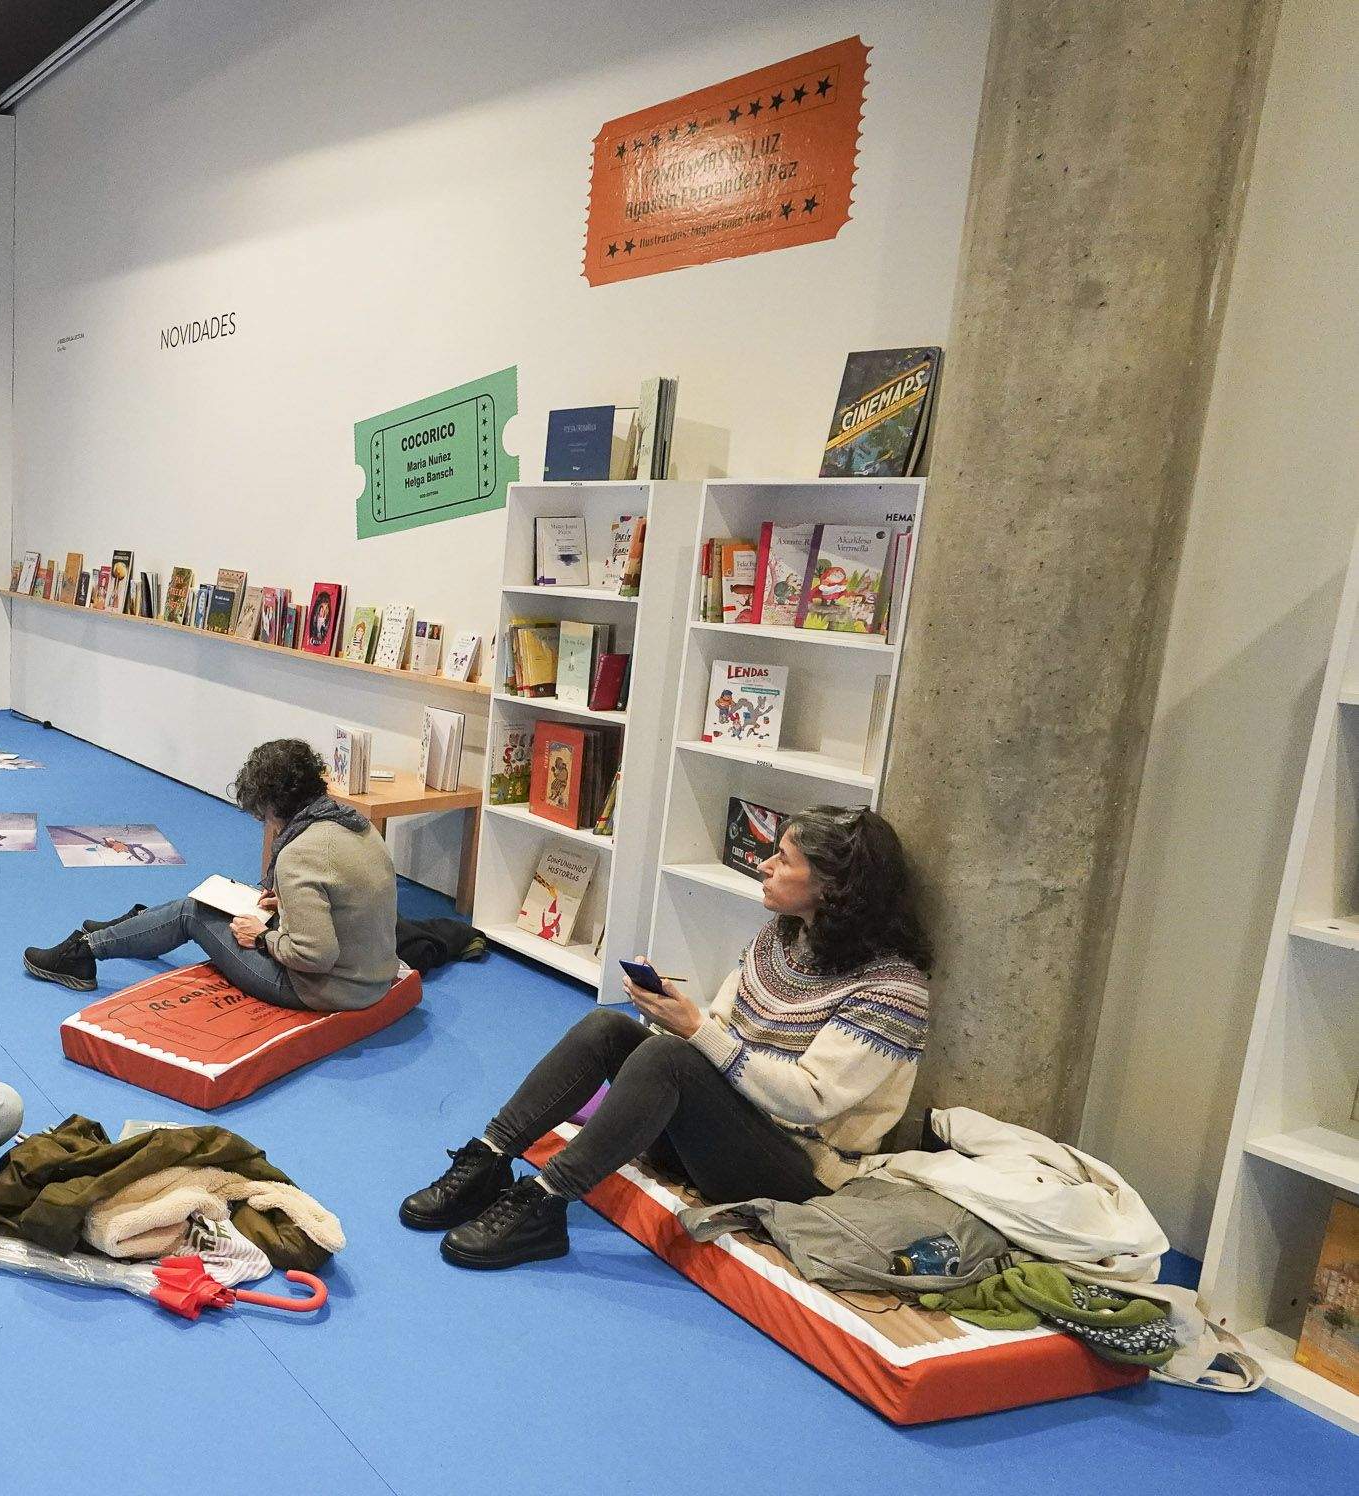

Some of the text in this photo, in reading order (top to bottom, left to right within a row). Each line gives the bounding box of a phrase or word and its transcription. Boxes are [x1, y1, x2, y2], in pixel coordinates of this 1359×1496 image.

[751, 132, 782, 158] LUZ
[768, 161, 799, 182] Paz
[160, 312, 237, 350] NOVIDADES
[842, 370, 927, 431] CINEMAPS
[401, 421, 456, 451] COCORICO
[404, 466, 454, 489] Helga Bansch
[727, 665, 770, 679] LENDAS
[546, 854, 588, 874] CONFUNDINDO
[547, 865, 581, 882] HISTORIAS
